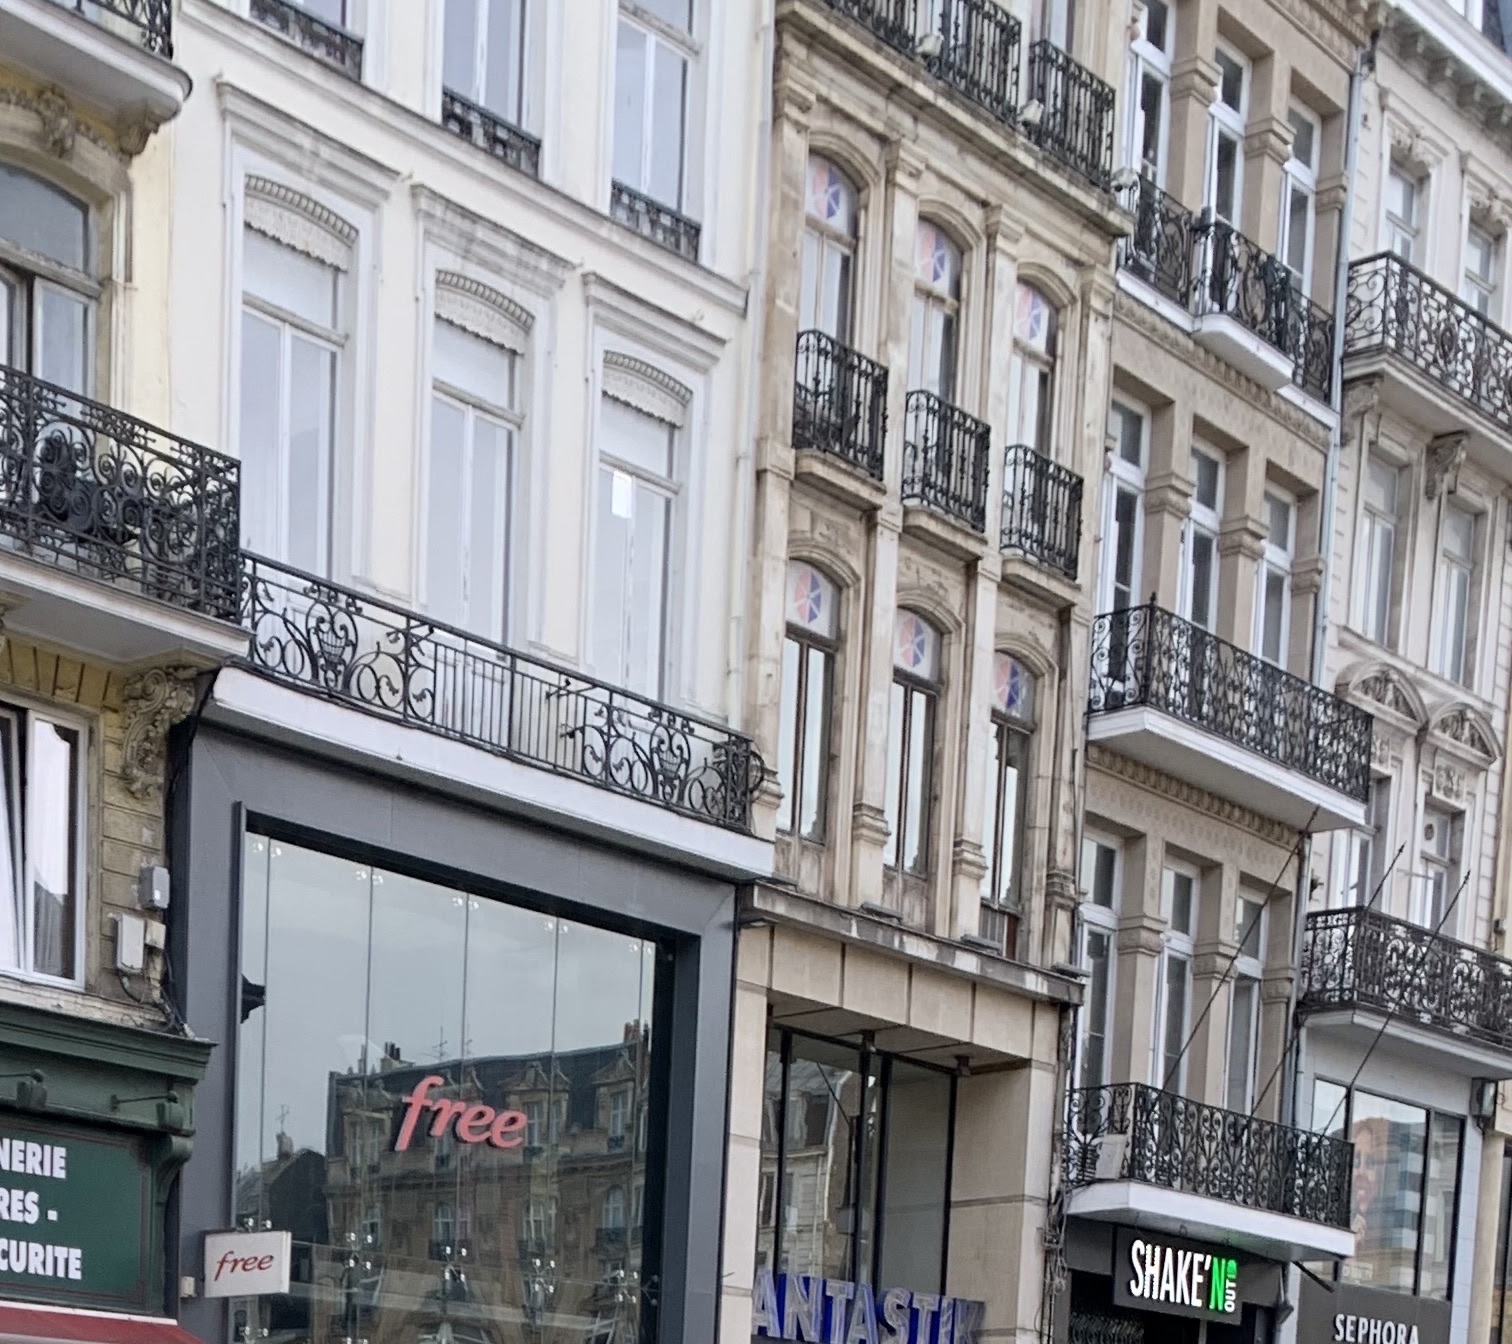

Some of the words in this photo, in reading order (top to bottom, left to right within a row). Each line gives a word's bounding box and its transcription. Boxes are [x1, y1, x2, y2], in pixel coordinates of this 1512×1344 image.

[395, 1075, 528, 1151] free
[214, 1251, 274, 1282] free
[1129, 1239, 1227, 1313] SHAKE'N
[1224, 1278, 1237, 1314] OUT
